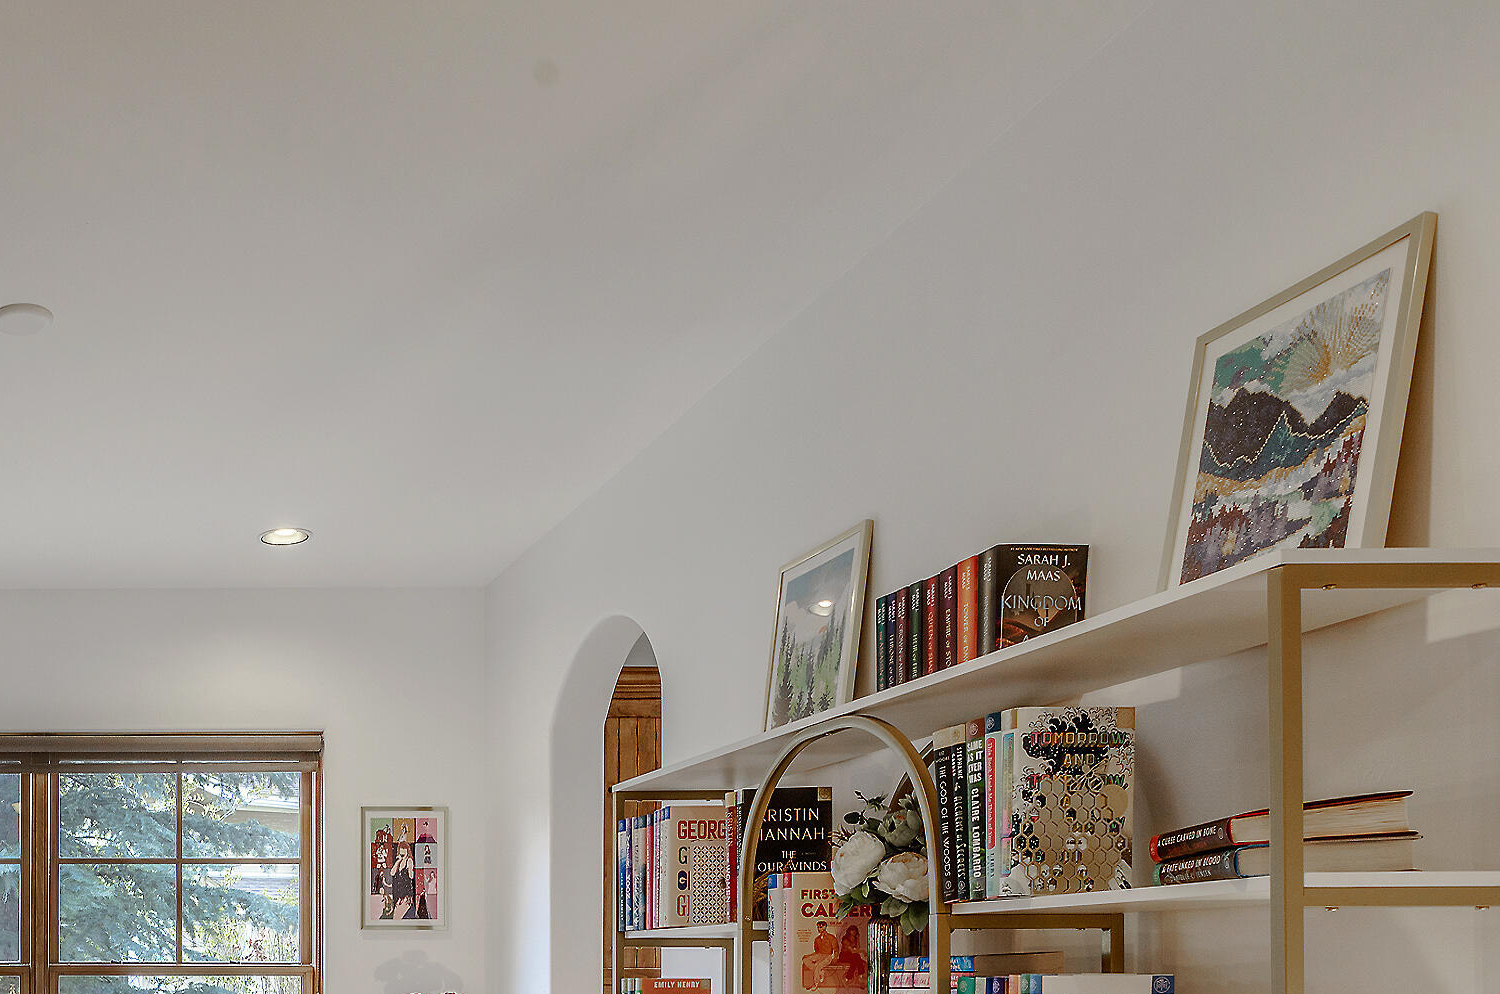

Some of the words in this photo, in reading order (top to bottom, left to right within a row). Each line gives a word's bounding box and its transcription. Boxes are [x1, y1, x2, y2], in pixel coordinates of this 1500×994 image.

[1017, 554, 1059, 566] SARAH
[1062, 554, 1071, 568] J.
[1026, 569, 1061, 581] MAAS
[1002, 594, 1082, 611] KINGDOM
[1034, 616, 1049, 627] OF
[967, 739, 983, 750] SAME
[1031, 732, 1126, 745] TOMORROW
[967, 753, 975, 762] AS
[975, 750, 983, 761] IT
[1064, 753, 1095, 765] AND
[938, 765, 947, 779] THE
[968, 762, 983, 773] EVER
[969, 773, 982, 784] WAS
[939, 782, 948, 805] GOD
[971, 788, 980, 822] CLAIRE
[940, 807, 948, 819] OF
[941, 821, 949, 835] THE
[1162, 836, 1176, 847] CURSE
[1176, 831, 1195, 843] CARVED
[1196, 829, 1202, 838] IN
[1203, 825, 1217, 837] BONE
[782, 850, 797, 859] THE
[942, 837, 951, 877] WOODS
[972, 825, 981, 878] LOMBARDO
[757, 861, 783, 872] OUR
[788, 860, 827, 872] WINDS
[1166, 863, 1179, 873] FATE
[1203, 855, 1221, 866] BLOOD
[801, 902, 872, 918] CALER
[654, 981, 675, 989] EMILY
